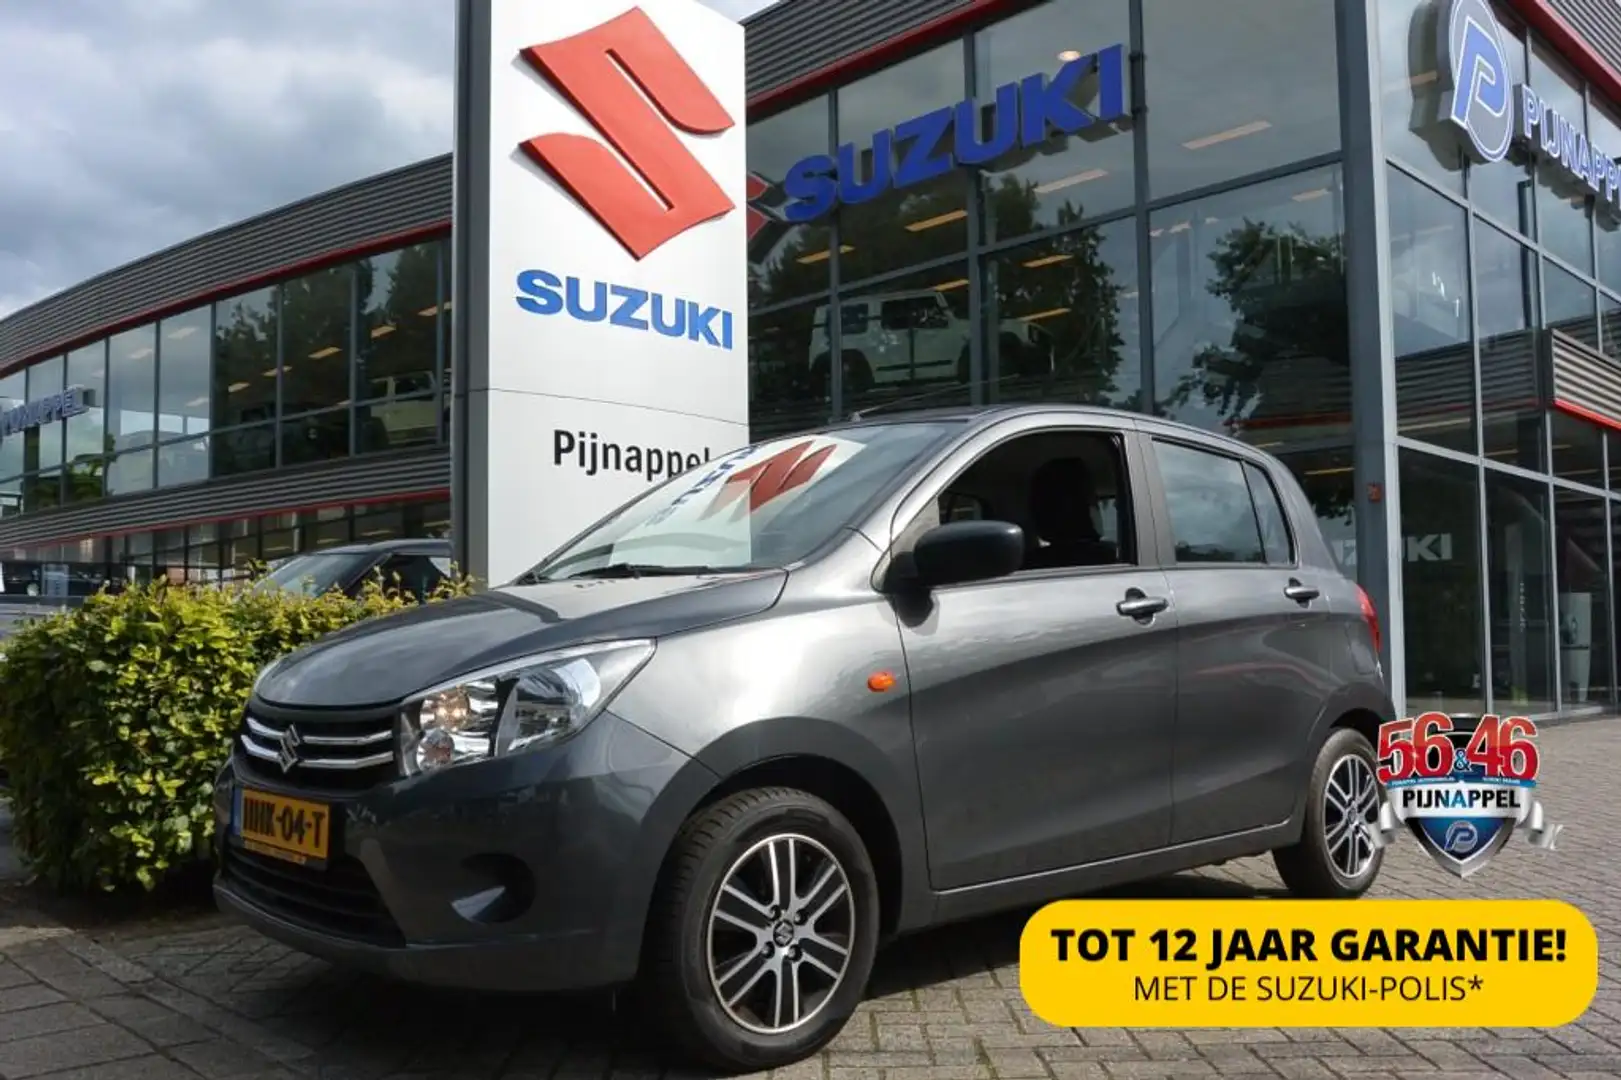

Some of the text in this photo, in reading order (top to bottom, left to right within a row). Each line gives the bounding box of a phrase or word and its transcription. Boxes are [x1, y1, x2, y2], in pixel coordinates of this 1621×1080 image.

[783, 43, 1126, 224] SUZUKI
[515, 269, 733, 351] SUZUKI
[553, 429, 710, 482] Pijnappel
